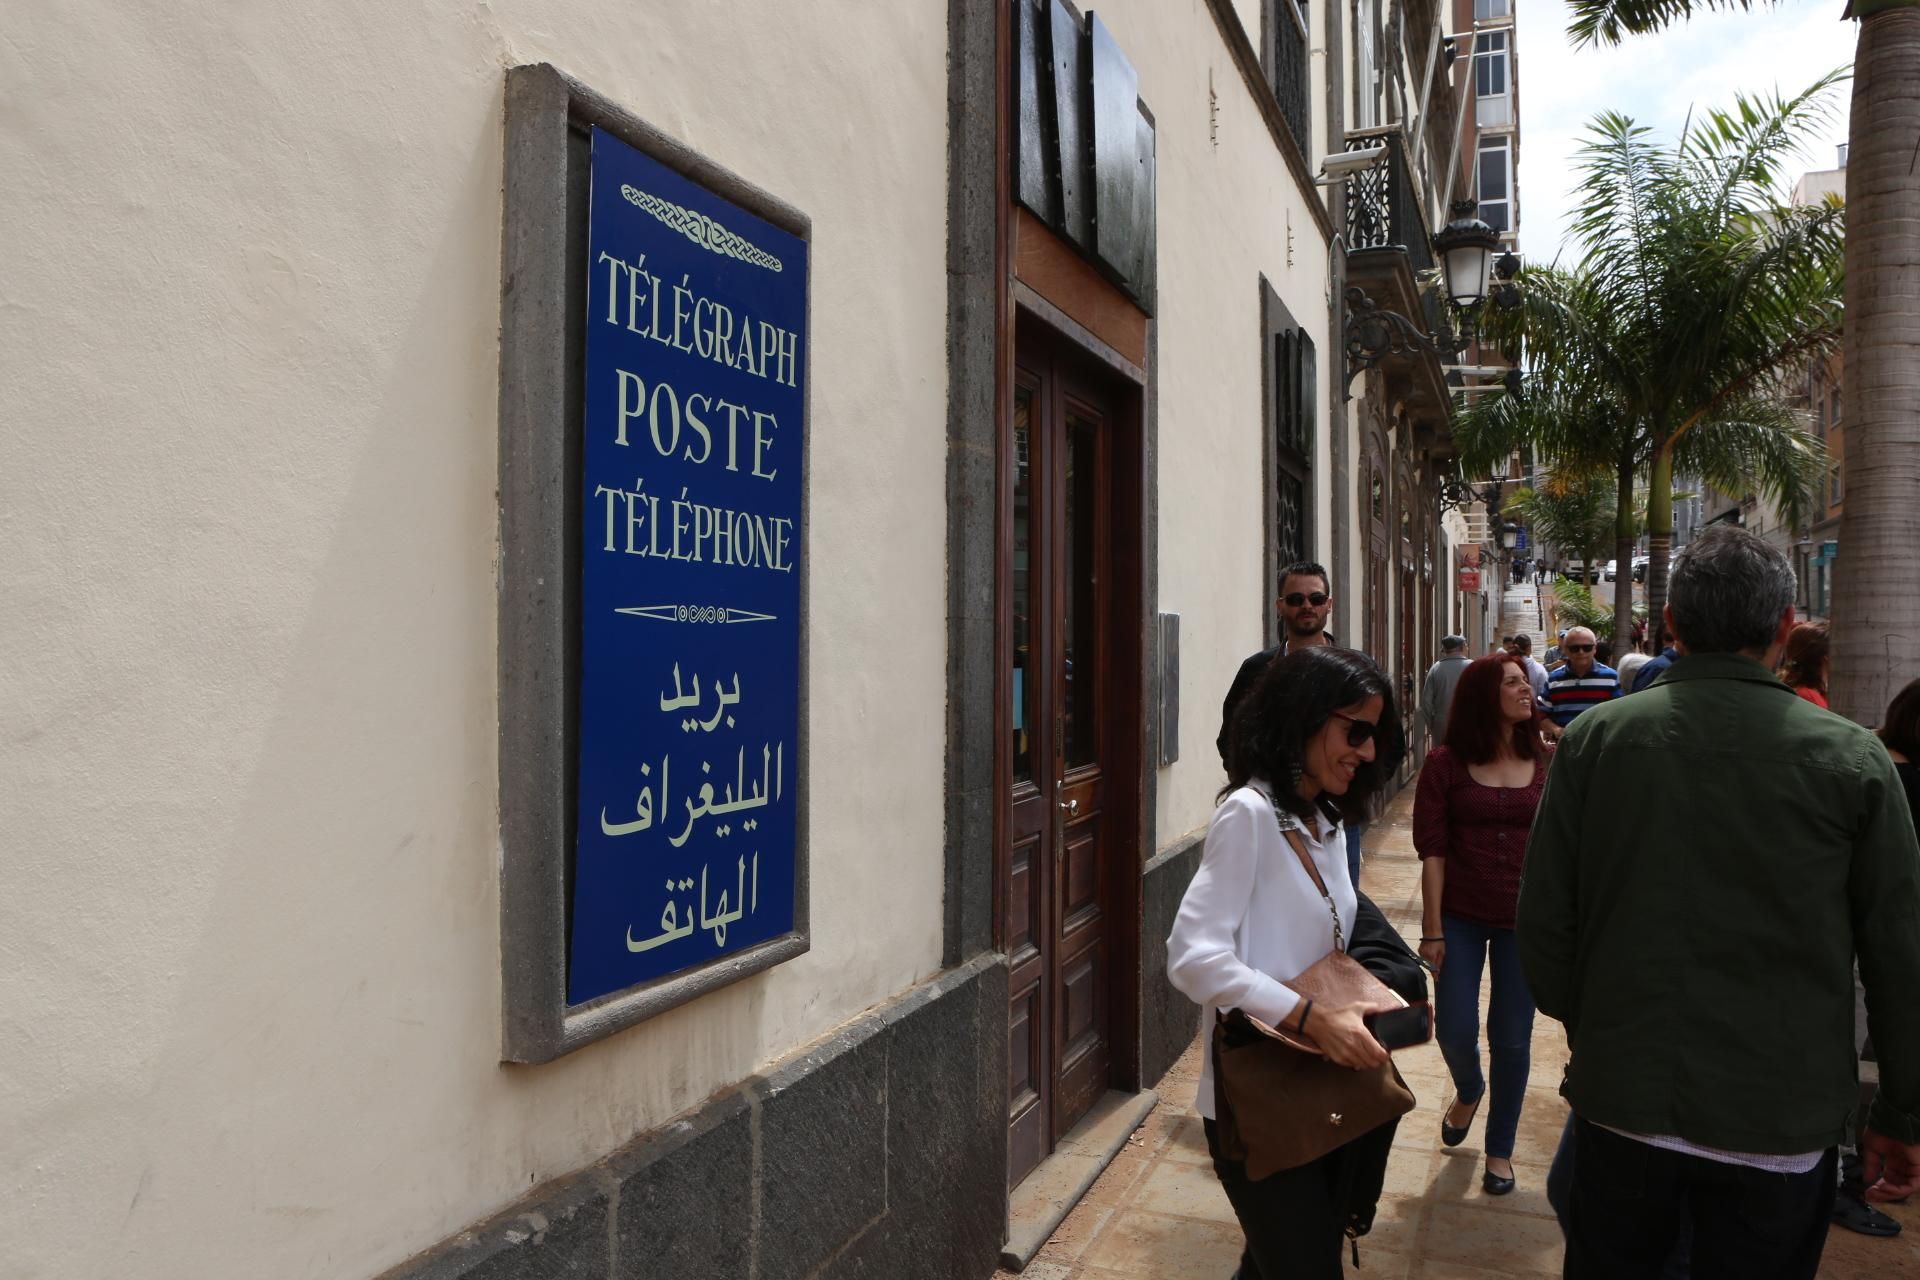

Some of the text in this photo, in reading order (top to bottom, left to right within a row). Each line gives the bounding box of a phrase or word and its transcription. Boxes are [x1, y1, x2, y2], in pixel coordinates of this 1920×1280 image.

[598, 250, 798, 388] TÉLÉGRAPH
[614, 368, 778, 482] POSTE
[594, 477, 793, 574] TÉLÉPHONE
[660, 661, 740, 732] بريد
[626, 850, 758, 953] الهاتف
